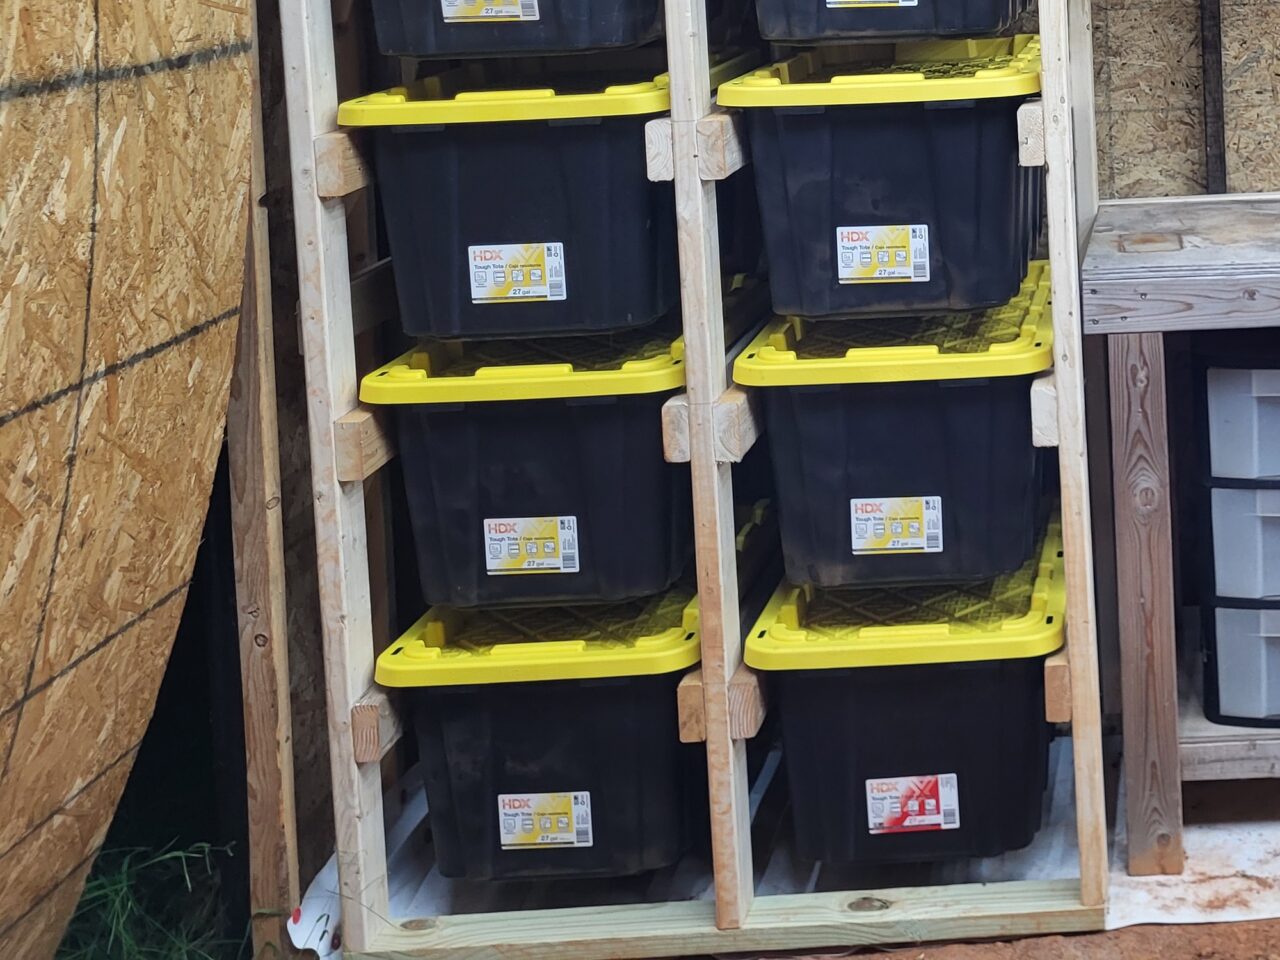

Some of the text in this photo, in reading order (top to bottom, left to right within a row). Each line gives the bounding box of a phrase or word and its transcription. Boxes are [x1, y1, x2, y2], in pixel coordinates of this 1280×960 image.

[841, 231, 870, 242] HDX
[473, 250, 503, 261] HDX
[854, 503, 883, 514] HDX
[488, 523, 517, 534] HDX
[870, 782, 900, 794] HDX
[502, 798, 531, 809] HDX
